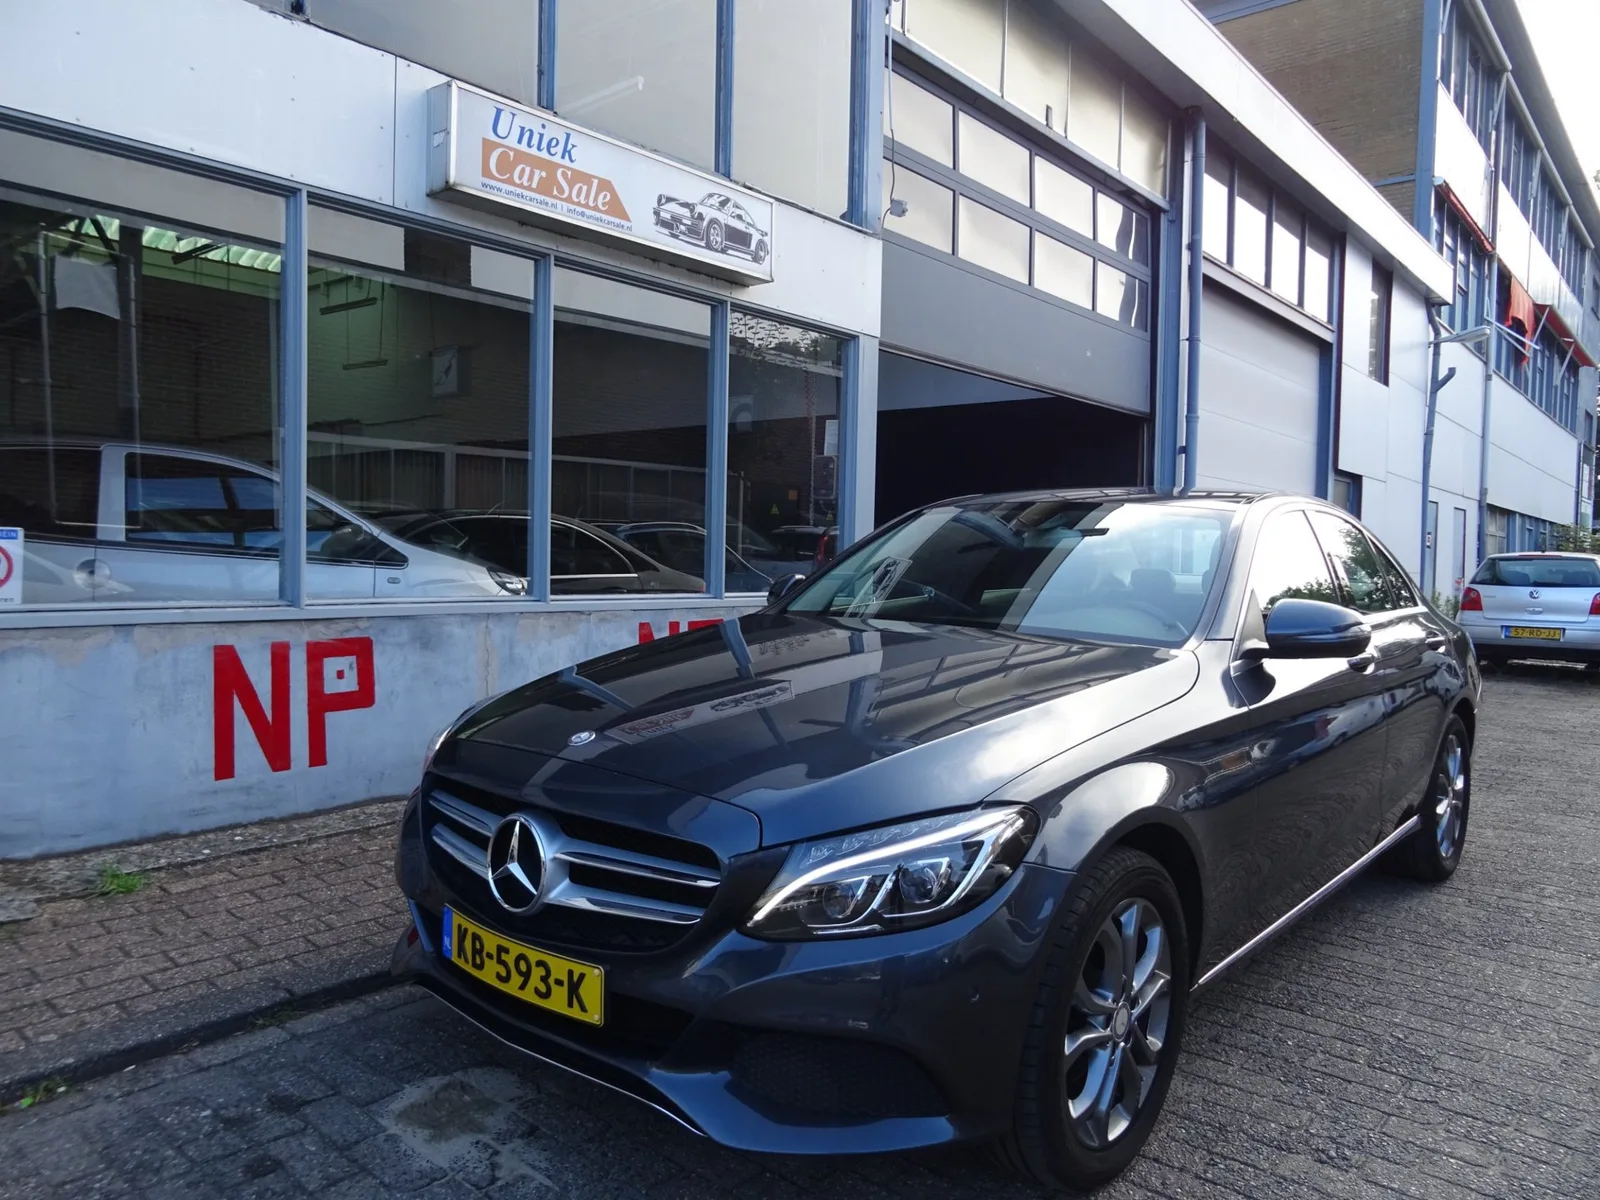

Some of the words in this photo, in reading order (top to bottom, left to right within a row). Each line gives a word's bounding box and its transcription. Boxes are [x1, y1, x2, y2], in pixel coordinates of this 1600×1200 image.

[492, 106, 577, 163] Uniek
[481, 181, 558, 210] www.uniekcarsale.nl
[566, 207, 633, 232] info@uniekcarsale.nl
[489, 147, 547, 189] Car
[553, 169, 611, 211] Sale
[213, 636, 376, 781] NP
[457, 923, 588, 1013] KB-593-K
